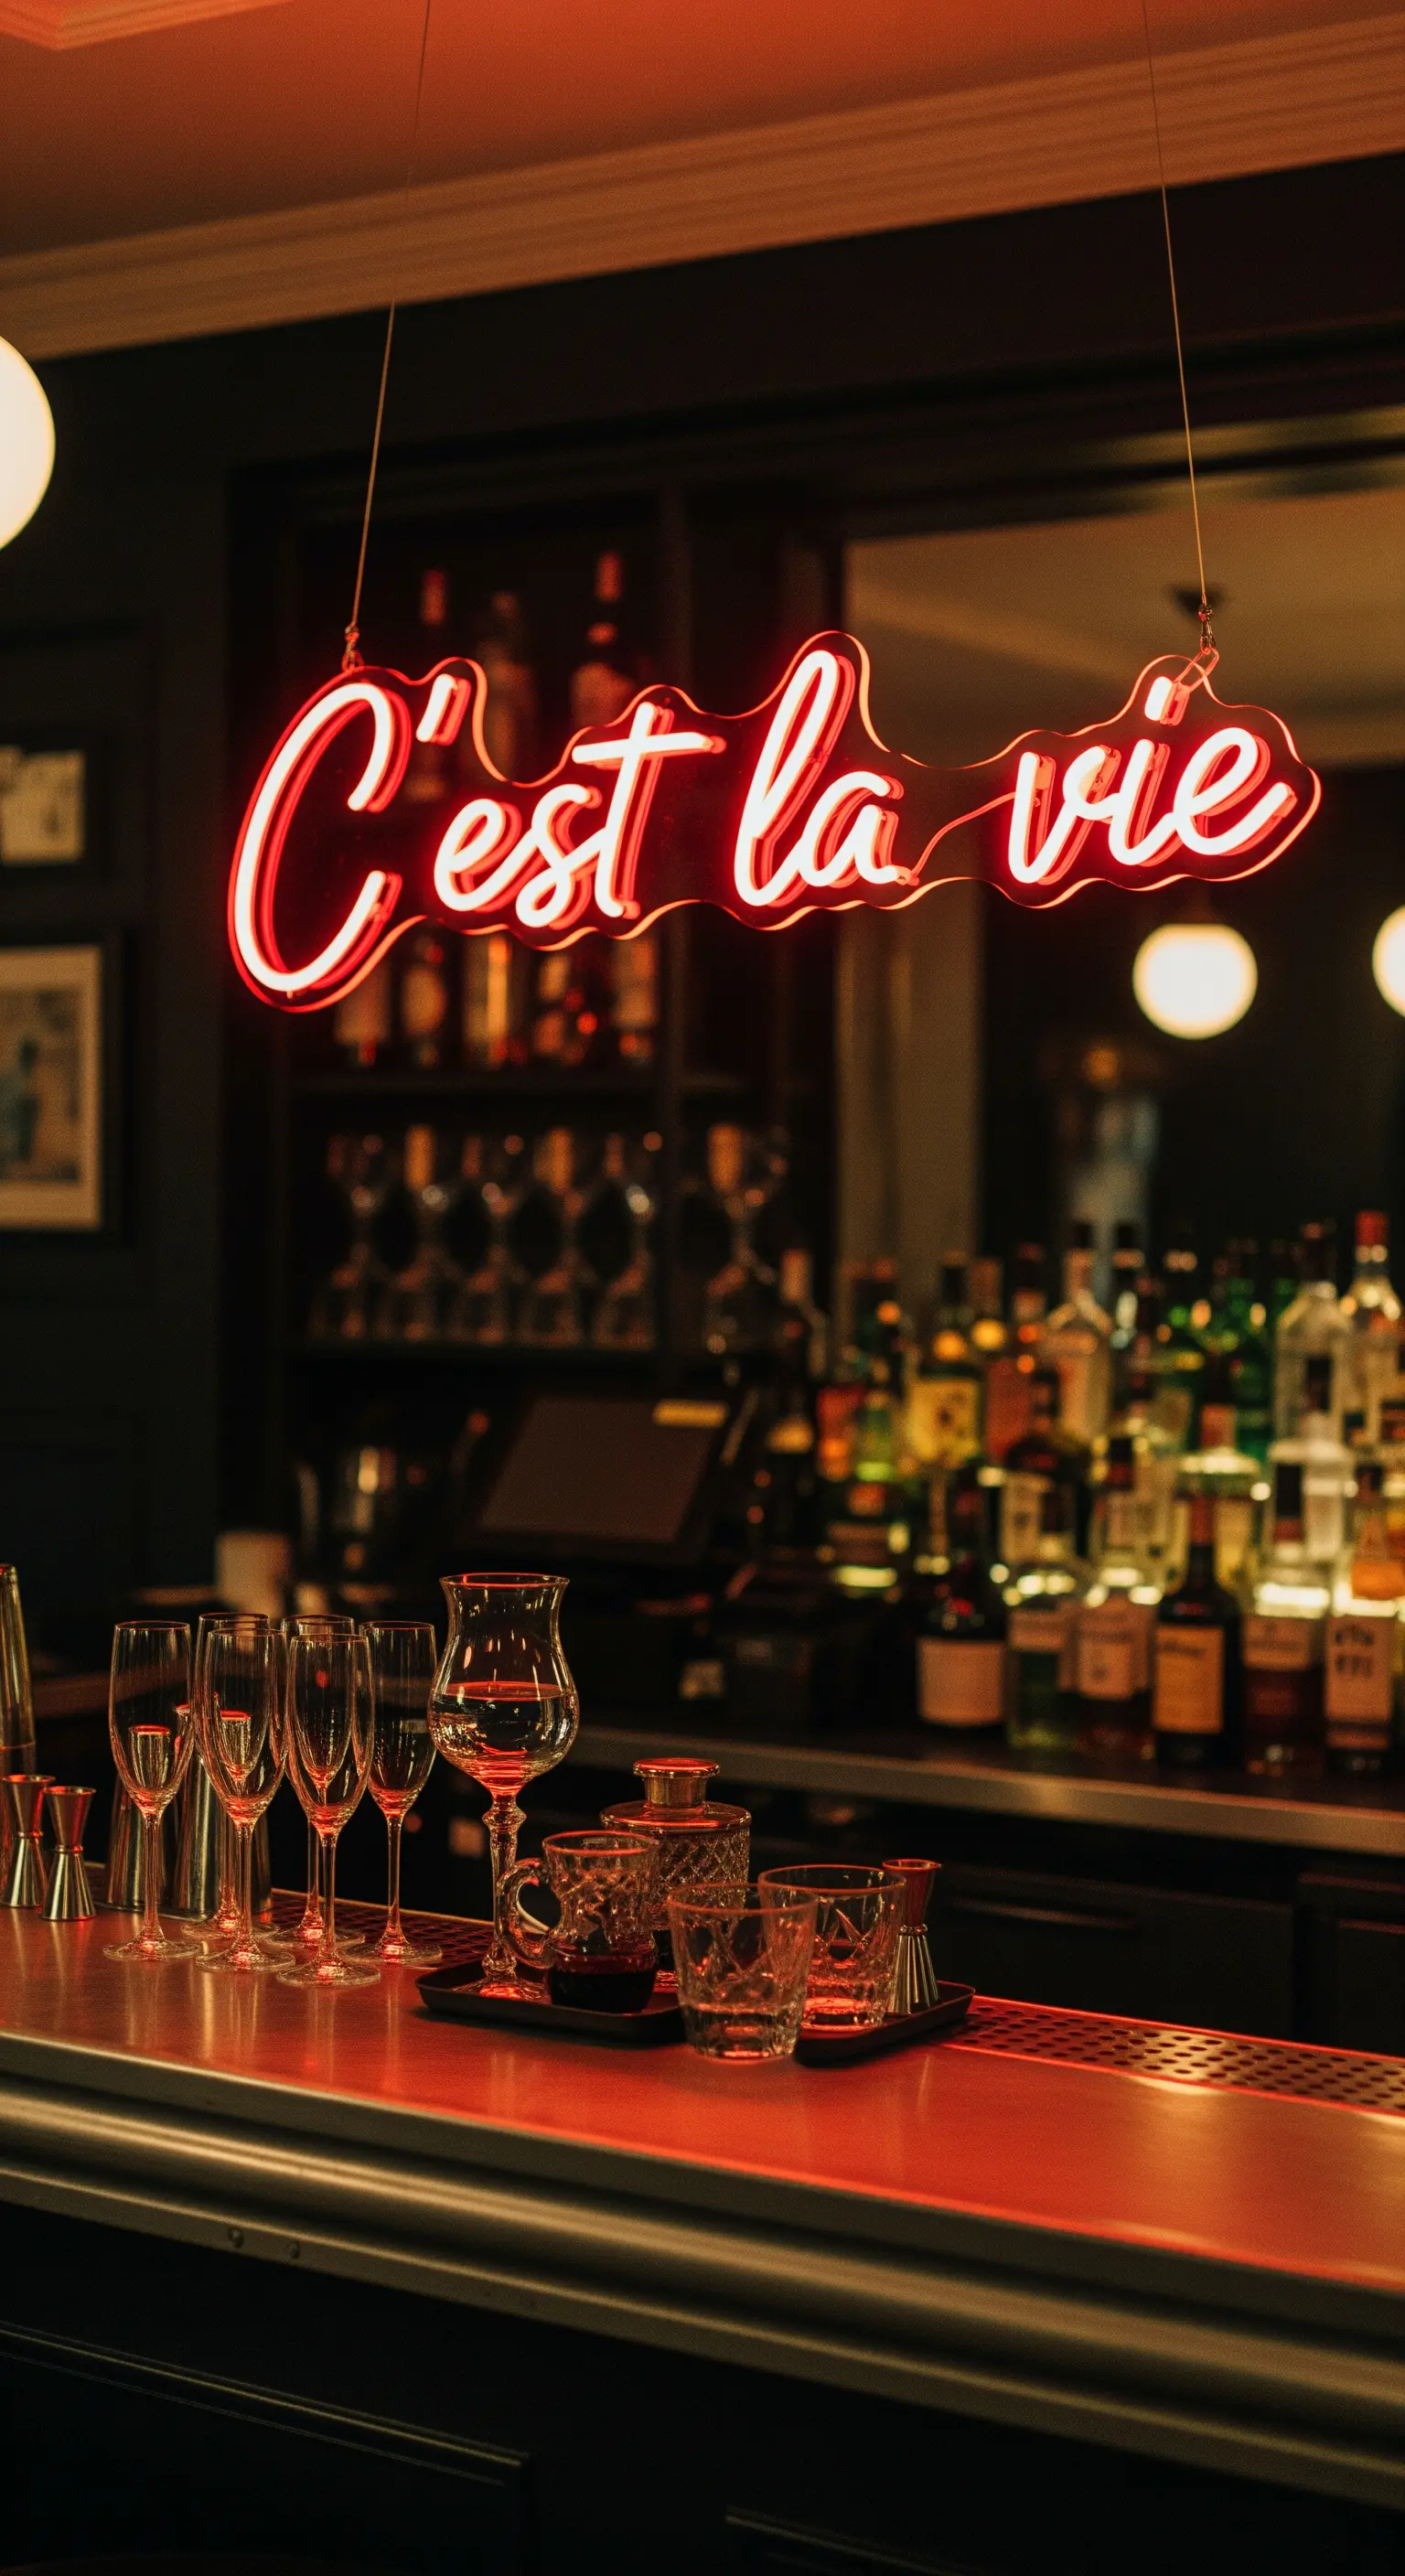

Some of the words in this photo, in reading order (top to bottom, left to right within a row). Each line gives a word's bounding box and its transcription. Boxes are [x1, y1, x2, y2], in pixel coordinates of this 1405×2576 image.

[232, 675, 724, 995] C'est
[733, 648, 907, 907] la
[1005, 674, 1295, 884] vie
